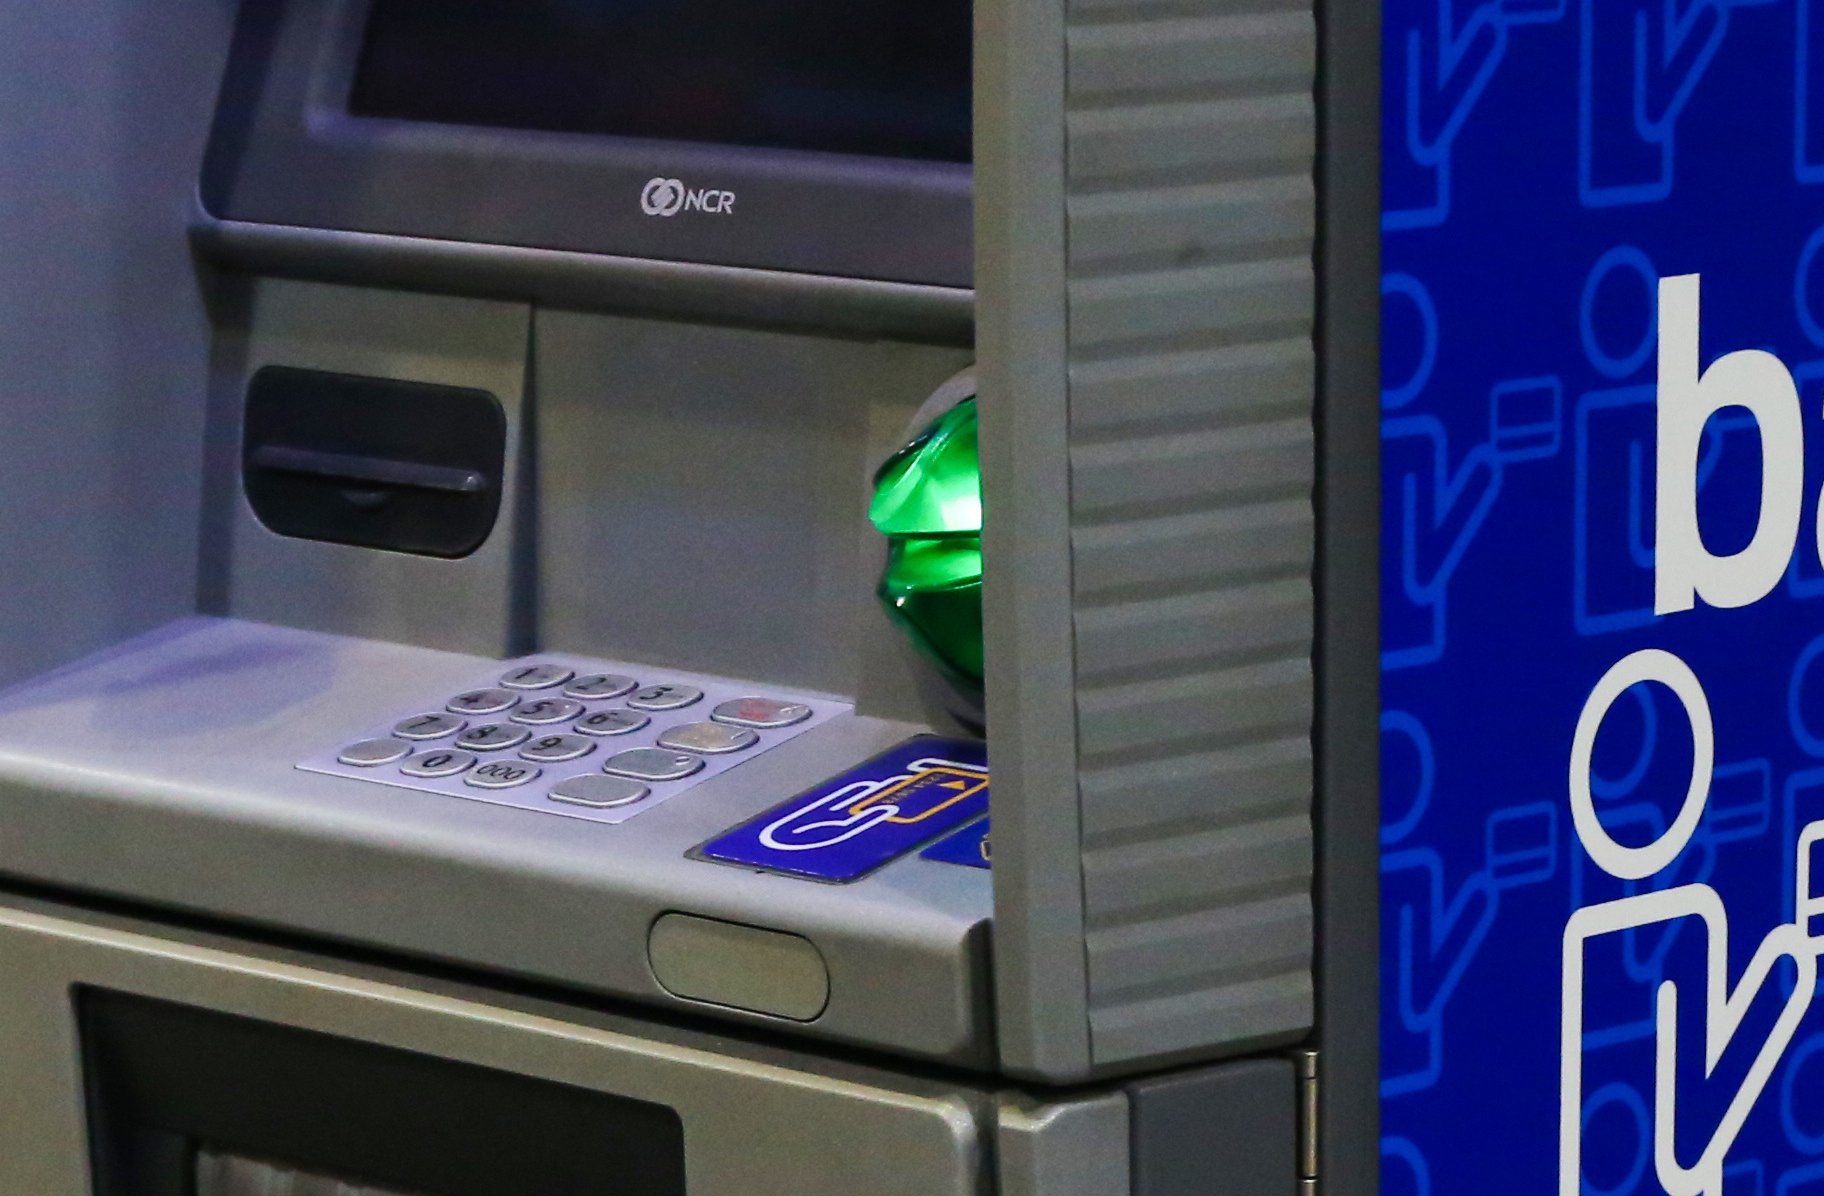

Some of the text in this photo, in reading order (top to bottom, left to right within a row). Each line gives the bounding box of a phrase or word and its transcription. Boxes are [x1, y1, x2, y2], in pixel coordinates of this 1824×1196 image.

[684, 188, 736, 215] NCR
[577, 677, 607, 691] 2
[639, 687, 673, 701] 3
[521, 701, 553, 715] 5
[408, 715, 441, 730] 7
[586, 712, 618, 726] 6
[466, 726, 498, 740] 8
[531, 737, 562, 752] 9
[422, 754, 453, 768] 0
[476, 764, 527, 781] 000
